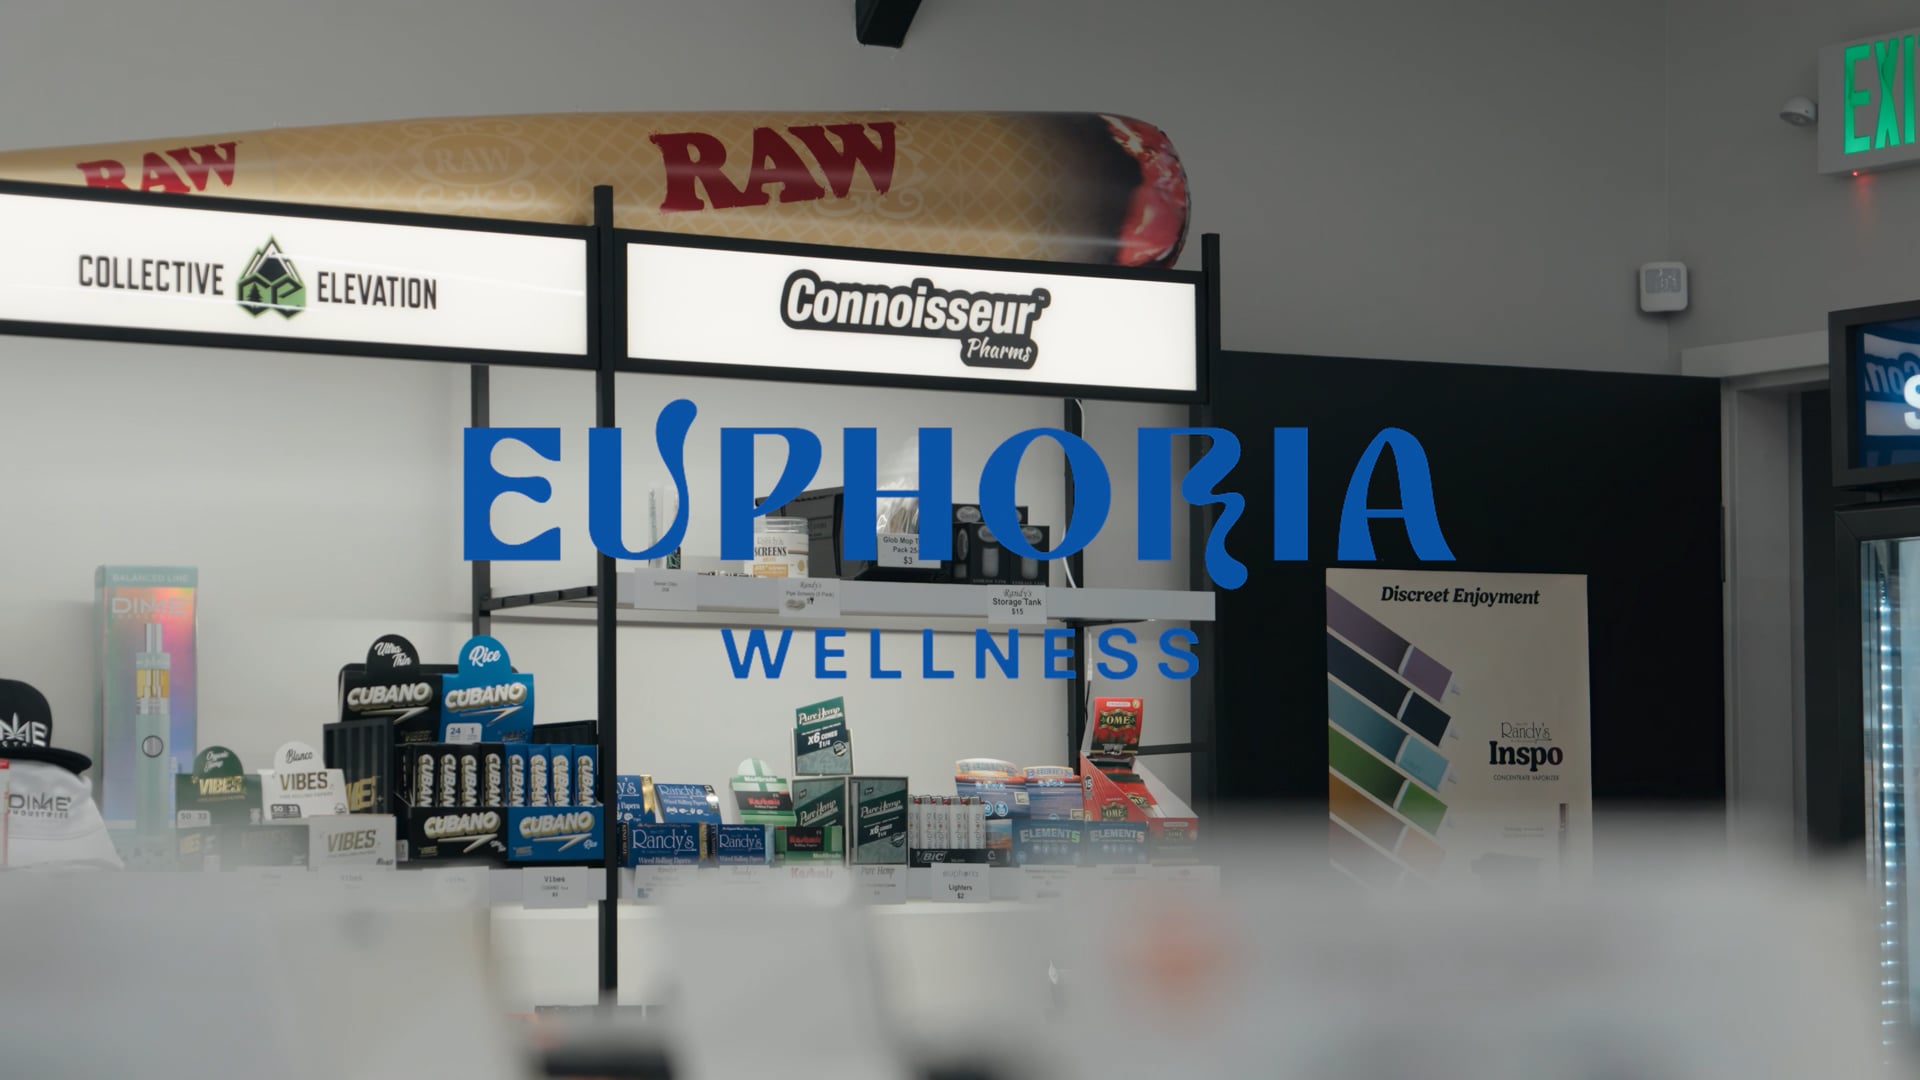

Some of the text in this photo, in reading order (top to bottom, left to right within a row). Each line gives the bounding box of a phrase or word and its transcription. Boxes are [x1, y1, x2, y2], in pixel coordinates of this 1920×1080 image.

[1843, 33, 1920, 155] EXI
[76, 141, 237, 195] RAW
[648, 121, 897, 214] RAW
[78, 253, 437, 310] COLLECTIVE ELEVATION
[786, 276, 1036, 335] Connoisseur
[966, 336, 1033, 363] Pharms
[882, 536, 899, 545] Glob
[899, 537, 913, 547] Mop
[892, 546, 908, 554] Pack
[903, 556, 913, 566] $3
[111, 596, 185, 614] DIME
[992, 598, 1042, 608] Storage Tank
[1381, 586, 1540, 608] Discreet Enjoyment
[1011, 608, 1024, 616] $15
[468, 645, 501, 667] Rice
[347, 682, 433, 711] CUBANO
[445, 682, 527, 711] CUBANO
[798, 707, 841, 725] Pure Hemp
[1501, 721, 1551, 744] Randy's
[286, 749, 313, 764] Blanco
[1488, 740, 1563, 772] Inspo
[199, 775, 243, 795] VIBES
[280, 772, 328, 791] VIBES
[657, 784, 703, 799] Randy's
[8, 792, 69, 812] DIME
[424, 811, 500, 839] CUBANO
[519, 811, 595, 839] CUBANO
[1020, 828, 1081, 843] ELEMENTS
[328, 830, 377, 853] VIBES
[632, 829, 696, 855] Randy's
[719, 834, 763, 851] Randy's
[1090, 829, 1145, 843] ELEMENTS
[948, 884, 973, 892] Lighters
